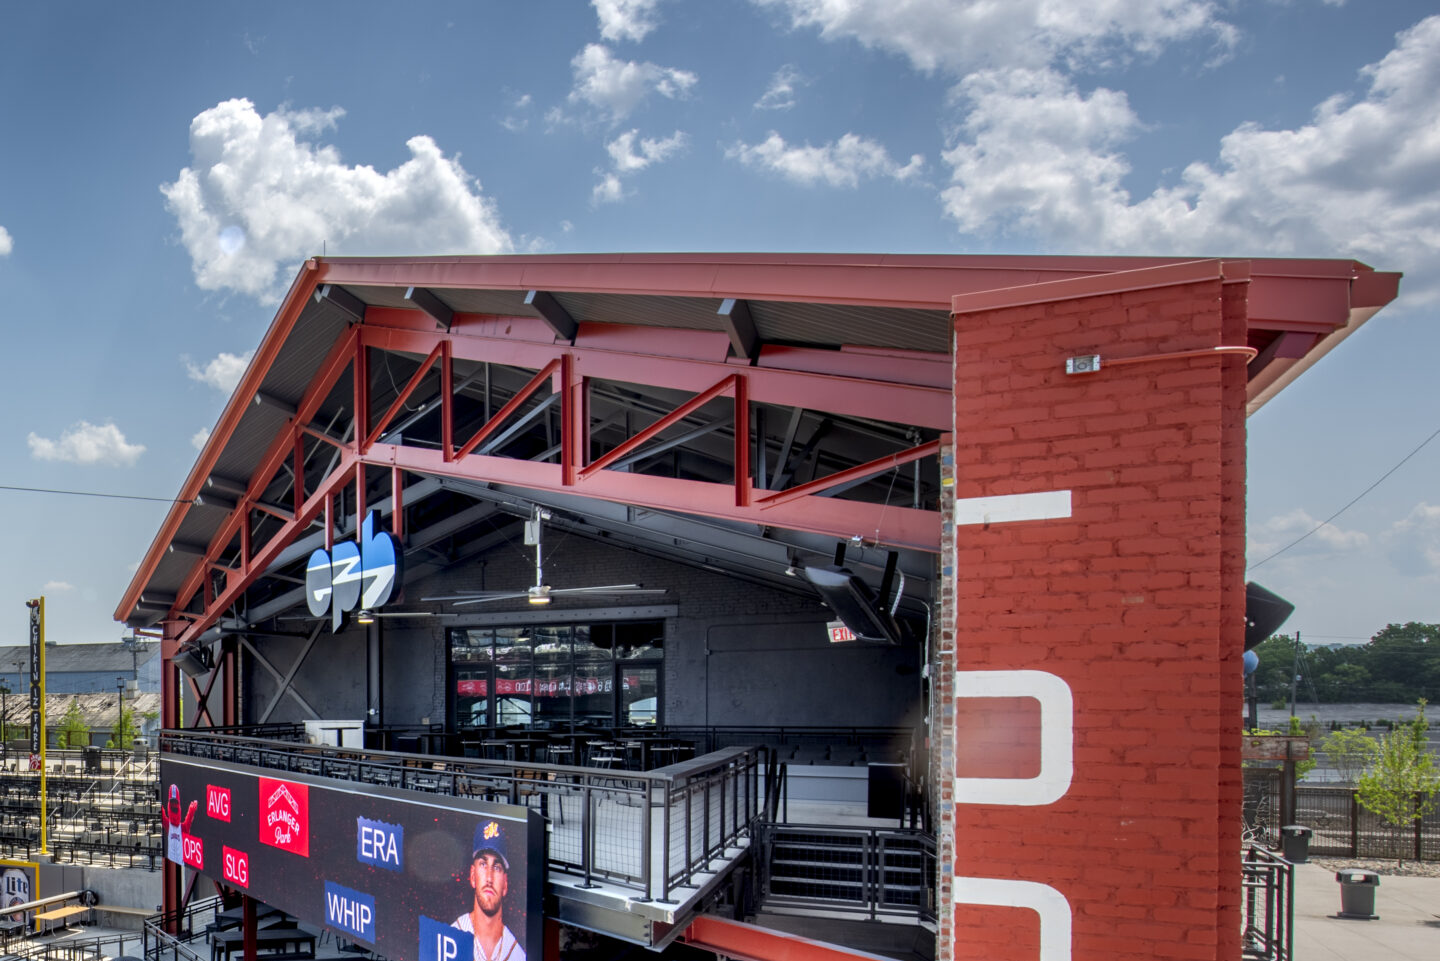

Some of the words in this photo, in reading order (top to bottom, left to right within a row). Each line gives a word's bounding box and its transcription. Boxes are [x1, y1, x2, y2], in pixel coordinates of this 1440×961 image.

[208, 791, 229, 817] AVG
[267, 810, 300, 836] ERLANGER
[275, 825, 292, 844] Park
[183, 837, 202, 864] OPS
[361, 826, 400, 866] ERA
[225, 853, 247, 883] SLG
[6, 877, 29, 896] Lite
[327, 891, 372, 934] WHIP
